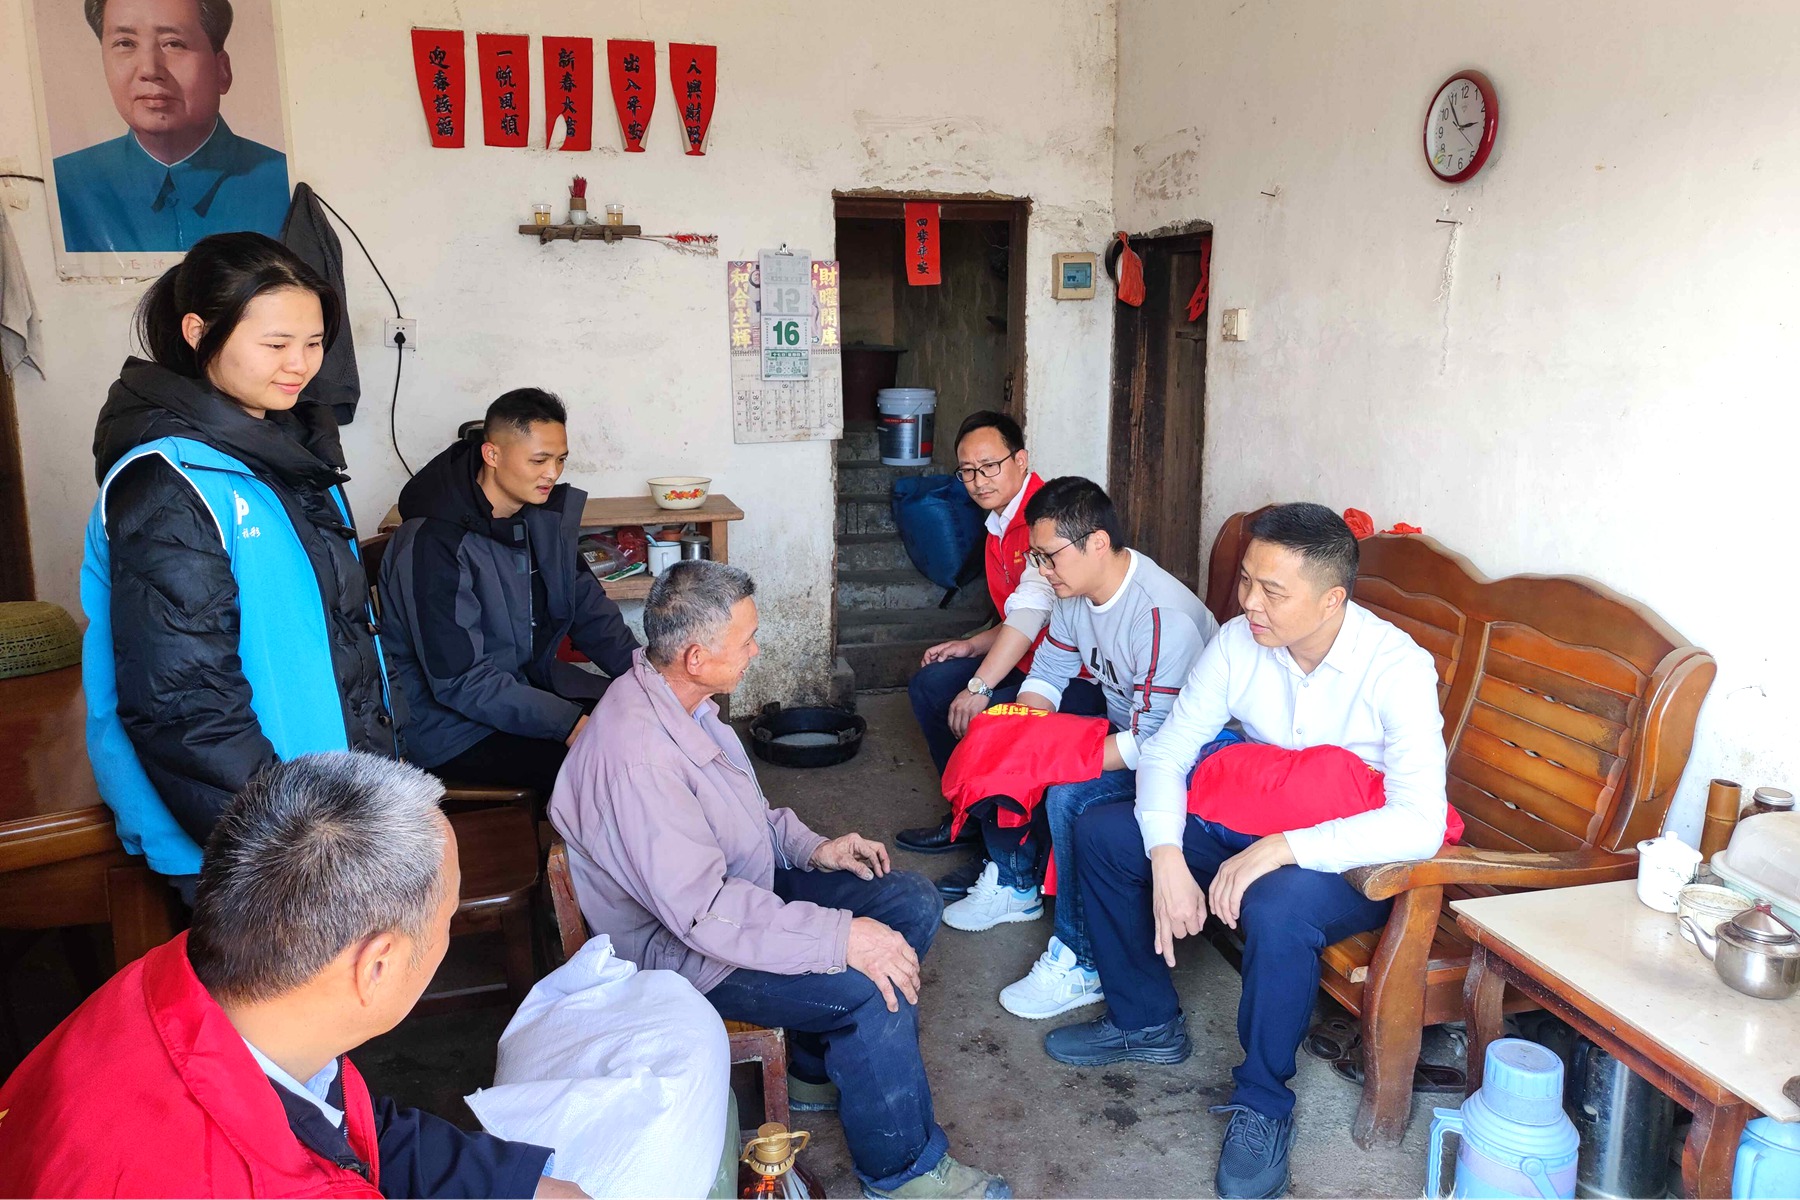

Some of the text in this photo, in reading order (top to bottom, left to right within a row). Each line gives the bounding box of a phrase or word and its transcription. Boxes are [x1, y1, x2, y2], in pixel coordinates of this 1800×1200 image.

[496, 50, 520, 136] 一帆風順
[623, 53, 643, 140] 出入平安
[1461, 85, 1470, 99] 12
[1474, 88, 1479, 101] 1
[1441, 108, 1450, 121] 10
[1438, 126, 1444, 139] 9
[1447, 154, 1453, 168] 7
[1457, 157, 1463, 170] 6
[772, 321, 800, 346] 16
